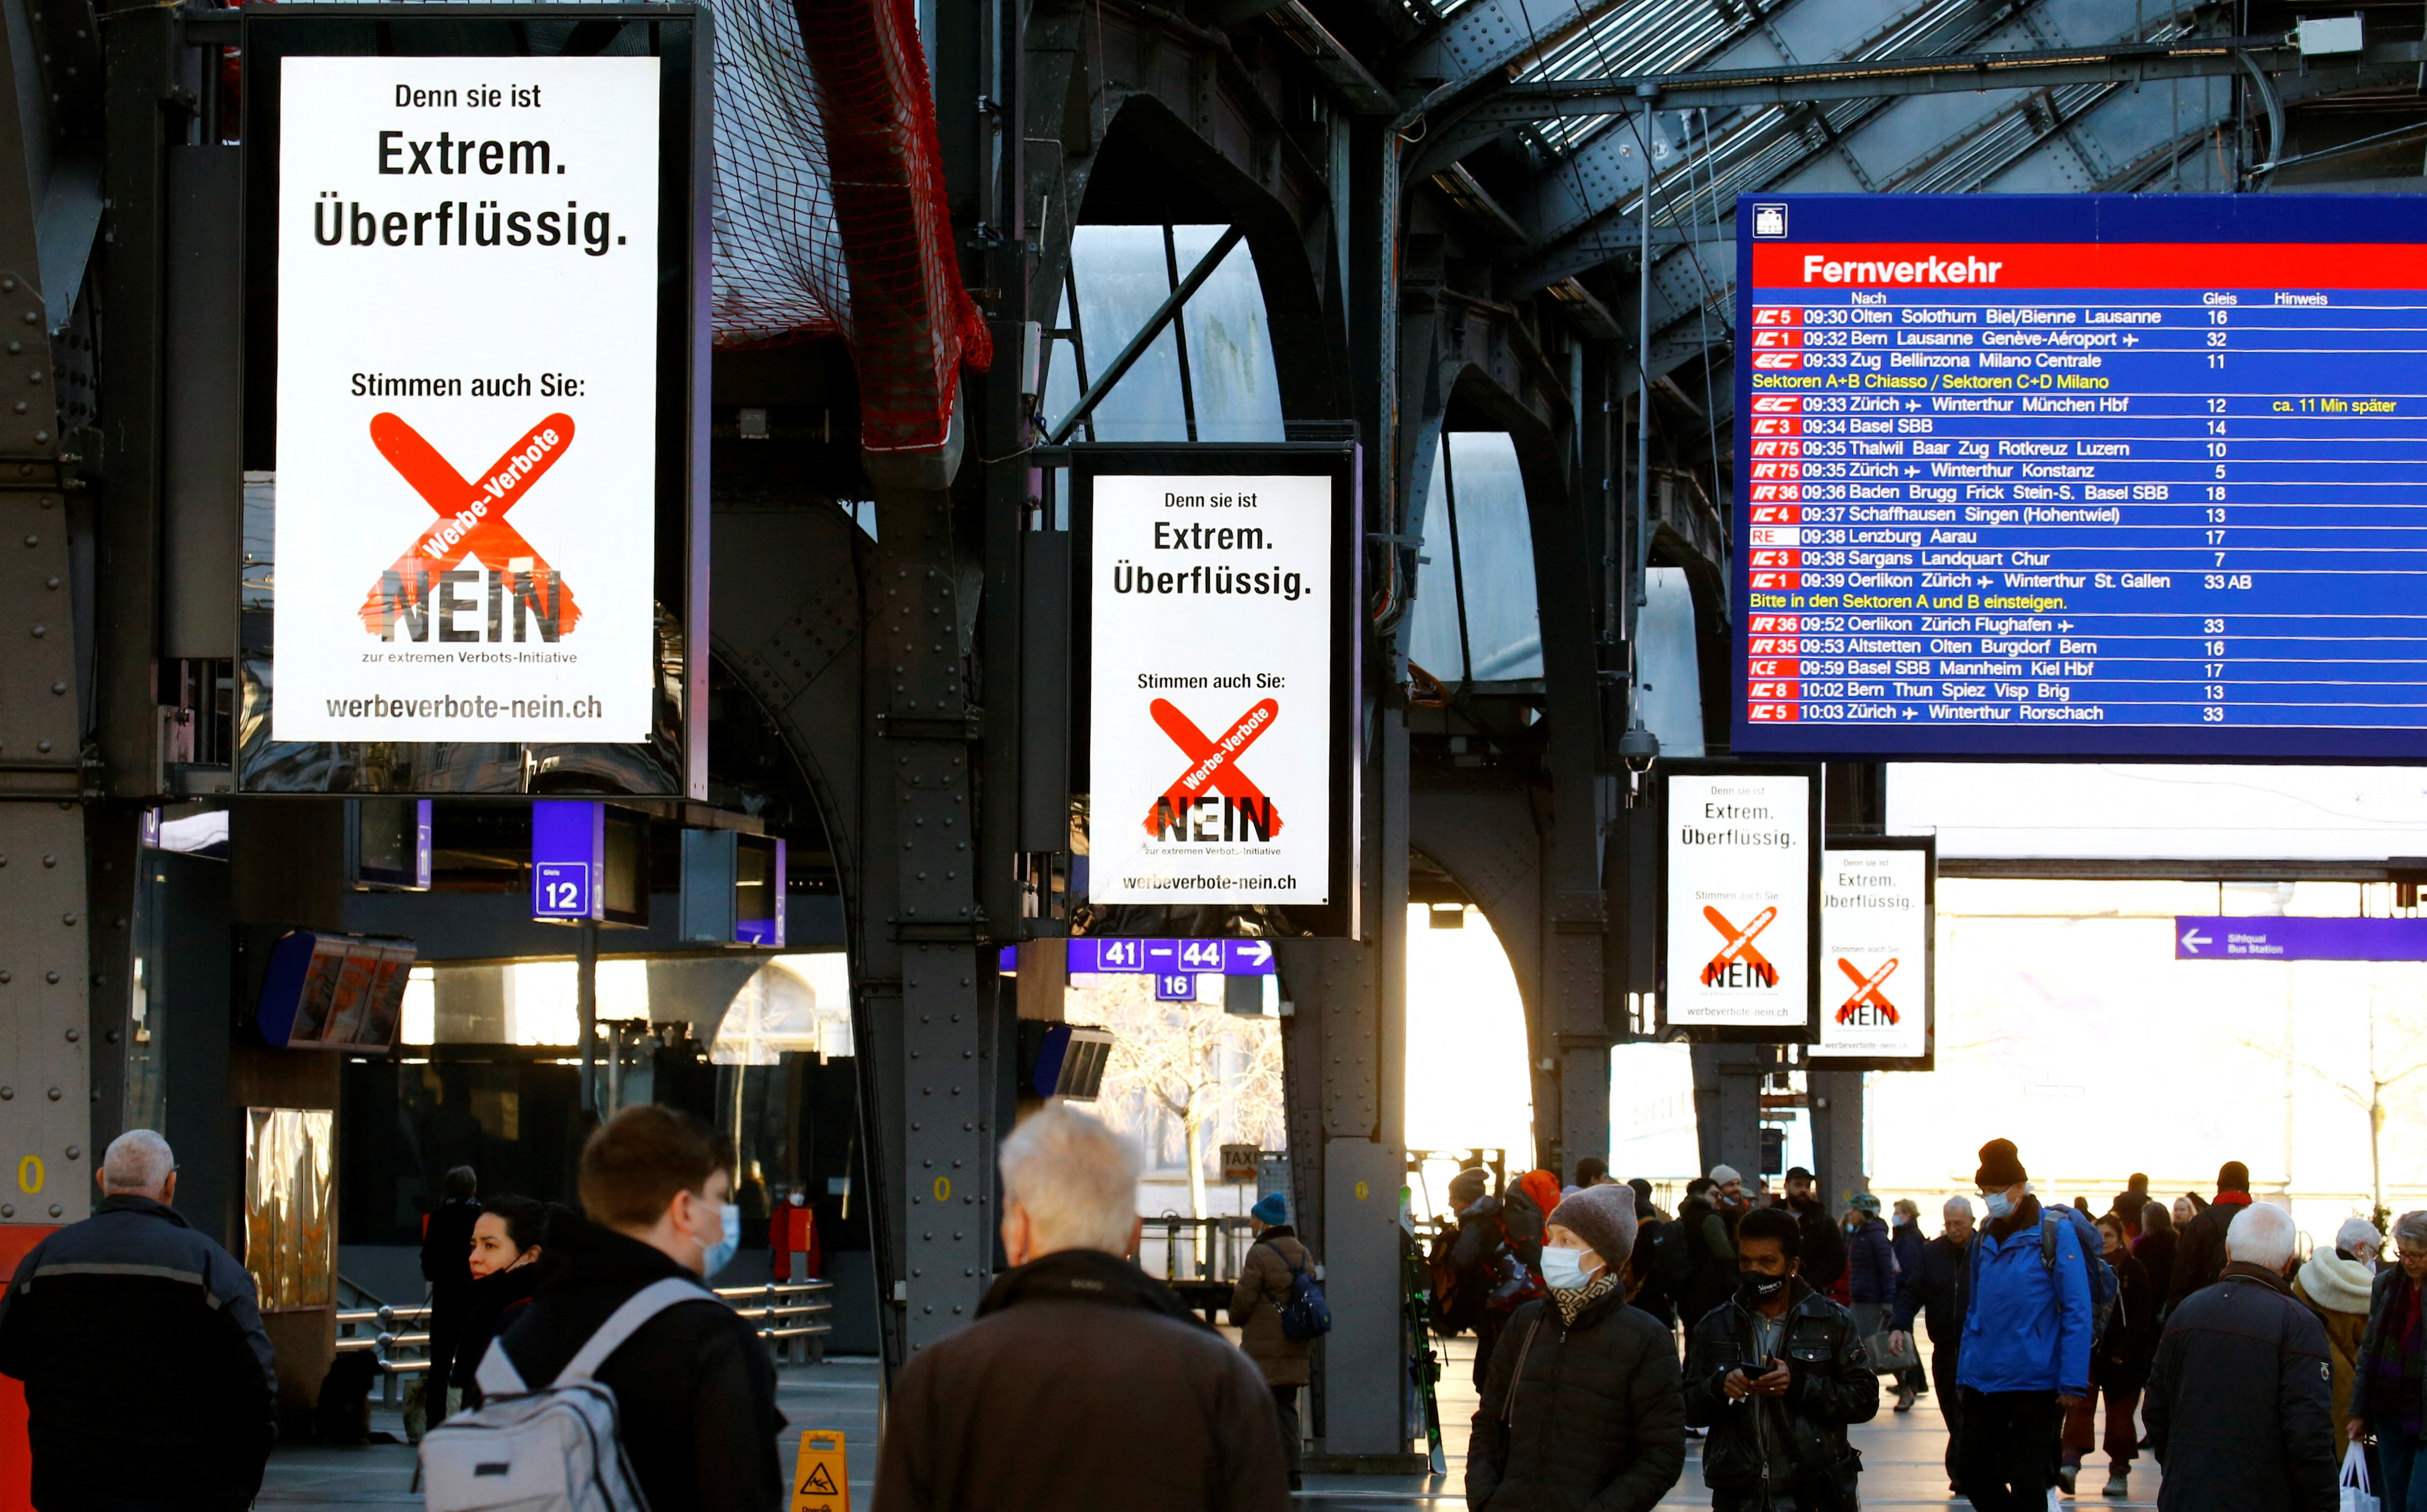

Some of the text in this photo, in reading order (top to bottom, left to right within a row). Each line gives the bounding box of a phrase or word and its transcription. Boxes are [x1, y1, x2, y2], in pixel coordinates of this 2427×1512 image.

[396, 84, 541, 107] Denn sie ist
[379, 131, 565, 175] Extrem.
[315, 191, 625, 256] Überflüssig.
[1803, 255, 2002, 283] Fernverkehr
[1851, 292, 2328, 306] Nach Gleis Hinweis
[1803, 308, 2228, 327] 09:30 Olten Solothurn Biel/Bienne Lausanne 16
[1803, 330, 2227, 349] 09:32 Bern Lausanne Genève-Aéroport 32
[1803, 352, 2224, 371] 09:33 Zug Bellinzona Milano Centrale 11
[352, 373, 584, 396] Stimmen auch Sie:
[1752, 373, 2109, 389] Sektoren A+B Chiasso Sektoren C+D Milano
[1802, 396, 2397, 415] 09:33 Zürich Winterthur München Hbf 12 ca. 11 Min später
[1802, 440, 2227, 459] 09:35 Thalwil Baar Zug Rotkreuz Luzern 10
[422, 426, 559, 559] Werbe-Verbote
[1166, 493, 1257, 507] Denn sie ist
[1802, 484, 2226, 503] 09:36 Baden Brugg Frick Stein-S. Basel SBB 18
[1802, 506, 2226, 525] 09:37 Schaffhausen Singen (Hohentwiel) 13
[1155, 522, 1272, 549] Extrem.
[1801, 528, 2226, 547] 09:38 Lenzburg Aarau 17
[1115, 560, 1310, 601] Überflüssig.
[1801, 572, 2252, 589] 09:39 Oerlikon Zürich Winterthur St. Gallen 33 AB
[381, 570, 561, 642] NEIN
[1750, 593, 2067, 613] Bitte in den Sektoren A und B einsteigen.
[389, 653, 453, 662] extremen
[458, 652, 577, 662] Verbots-Initiative
[1800, 638, 2225, 657] 09:53 Altstetten Olten Burgdorf Bern 16
[1139, 674, 1284, 688] Stimmen auch Sie:
[1800, 682, 2224, 701] 10:02 Bern Thun Spiez Visp Brig 13
[327, 694, 602, 719] werbeverbote-nein.ch
[1183, 707, 1269, 791] Werbe-Verbote
[1711, 786, 1734, 795] Denn
[1157, 797, 1270, 842] NEIN
[1706, 803, 1773, 819] Extrem.
[1682, 825, 1796, 849] Überflüssig.
[1123, 874, 1296, 889] werbeverbote-nein.ch
[1839, 873, 1896, 887] Extrem.
[546, 882, 578, 909] 12
[1696, 891, 1736, 900] Stimmen
[1105, 942, 1219, 966] 41 44
[2228, 944, 2284, 954] Bus Station
[1708, 962, 1772, 988] NEIN
[1164, 976, 1187, 994] 16
[1841, 1005, 1895, 1026] NEIN
[1225, 1152, 1258, 1165] TAXI
[18, 1155, 44, 1194] 0
[934, 1176, 951, 1201] 0
